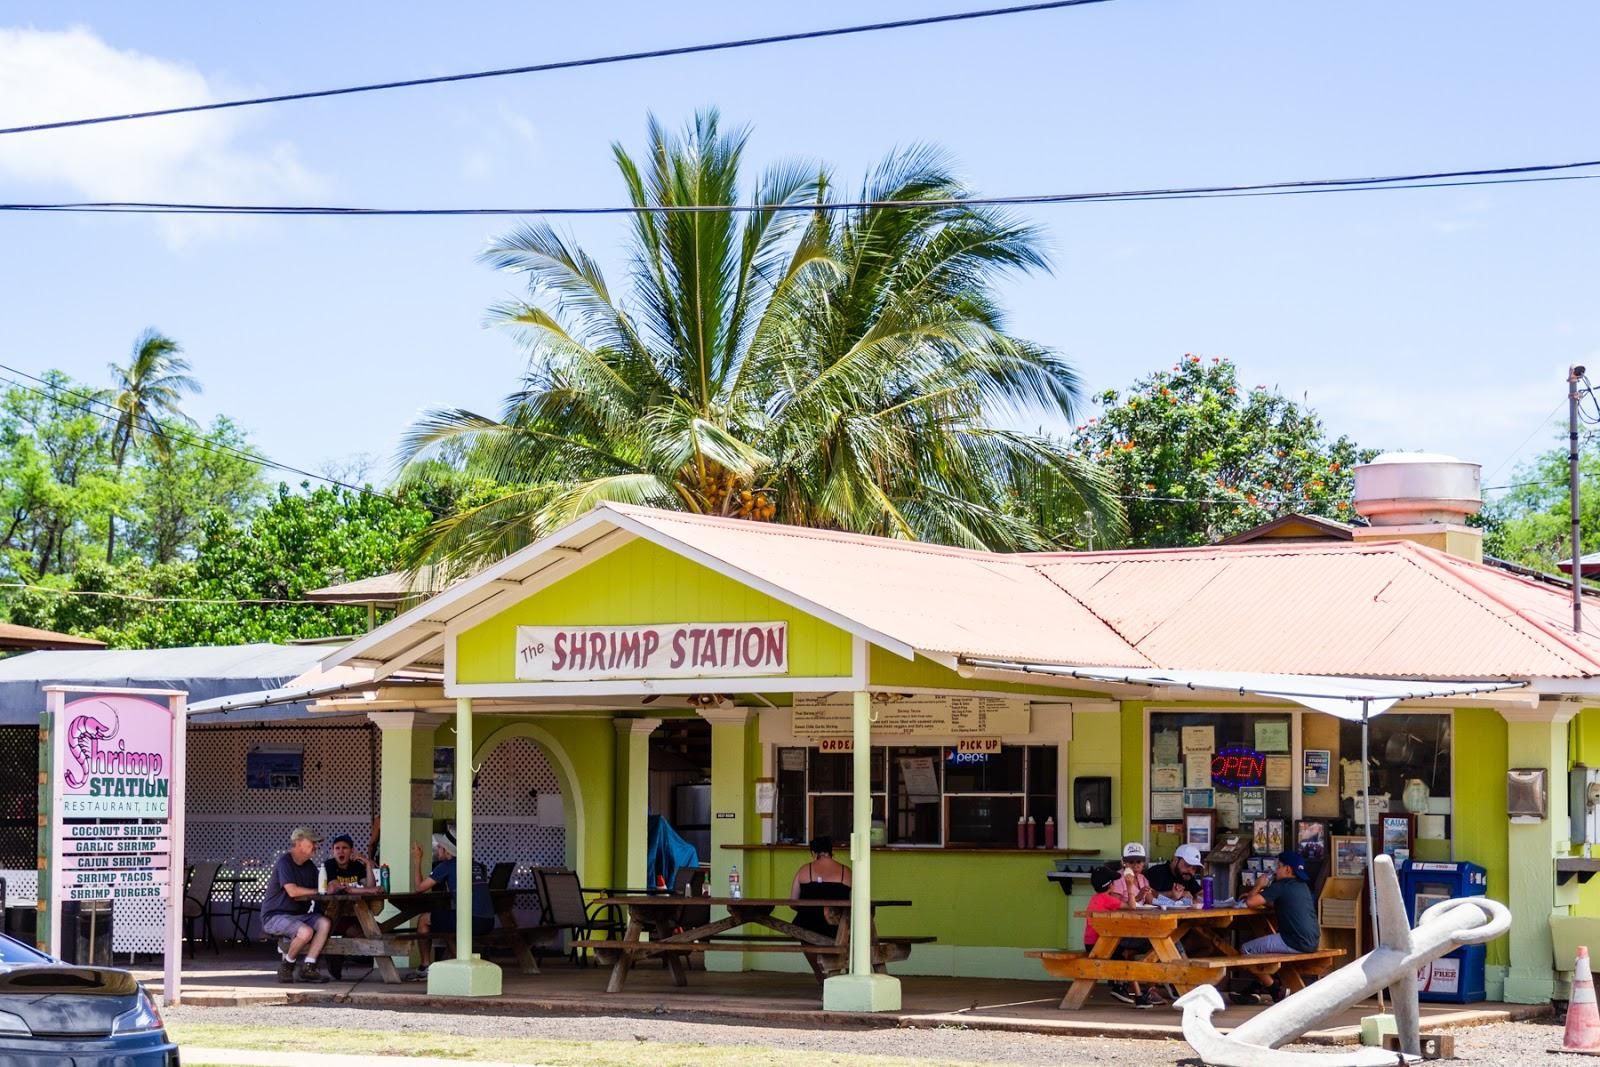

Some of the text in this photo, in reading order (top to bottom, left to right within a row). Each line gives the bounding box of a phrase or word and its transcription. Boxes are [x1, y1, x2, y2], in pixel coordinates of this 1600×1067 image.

[520, 626, 785, 671] The SHRIMP STATION
[822, 739, 854, 750] ORDE
[960, 739, 998, 750] PICK UP
[64, 714, 163, 789] Shrimp
[957, 752, 988, 764] pepsi
[1211, 755, 1265, 778] OPEN
[90, 777, 169, 798] STATION
[1242, 791, 1262, 799] PASS
[64, 801, 142, 813] RESTAURANT,
[72, 826, 162, 836] COCONUT SHRIMP
[76, 841, 156, 852] GARLIC SHRIMP
[78, 857, 152, 868] CAJUN SHRIMP
[77, 872, 153, 883] SHRIMP TACOS
[70, 887, 161, 899] SHRIMP BURGERS
[1433, 970, 1457, 978] FREE
